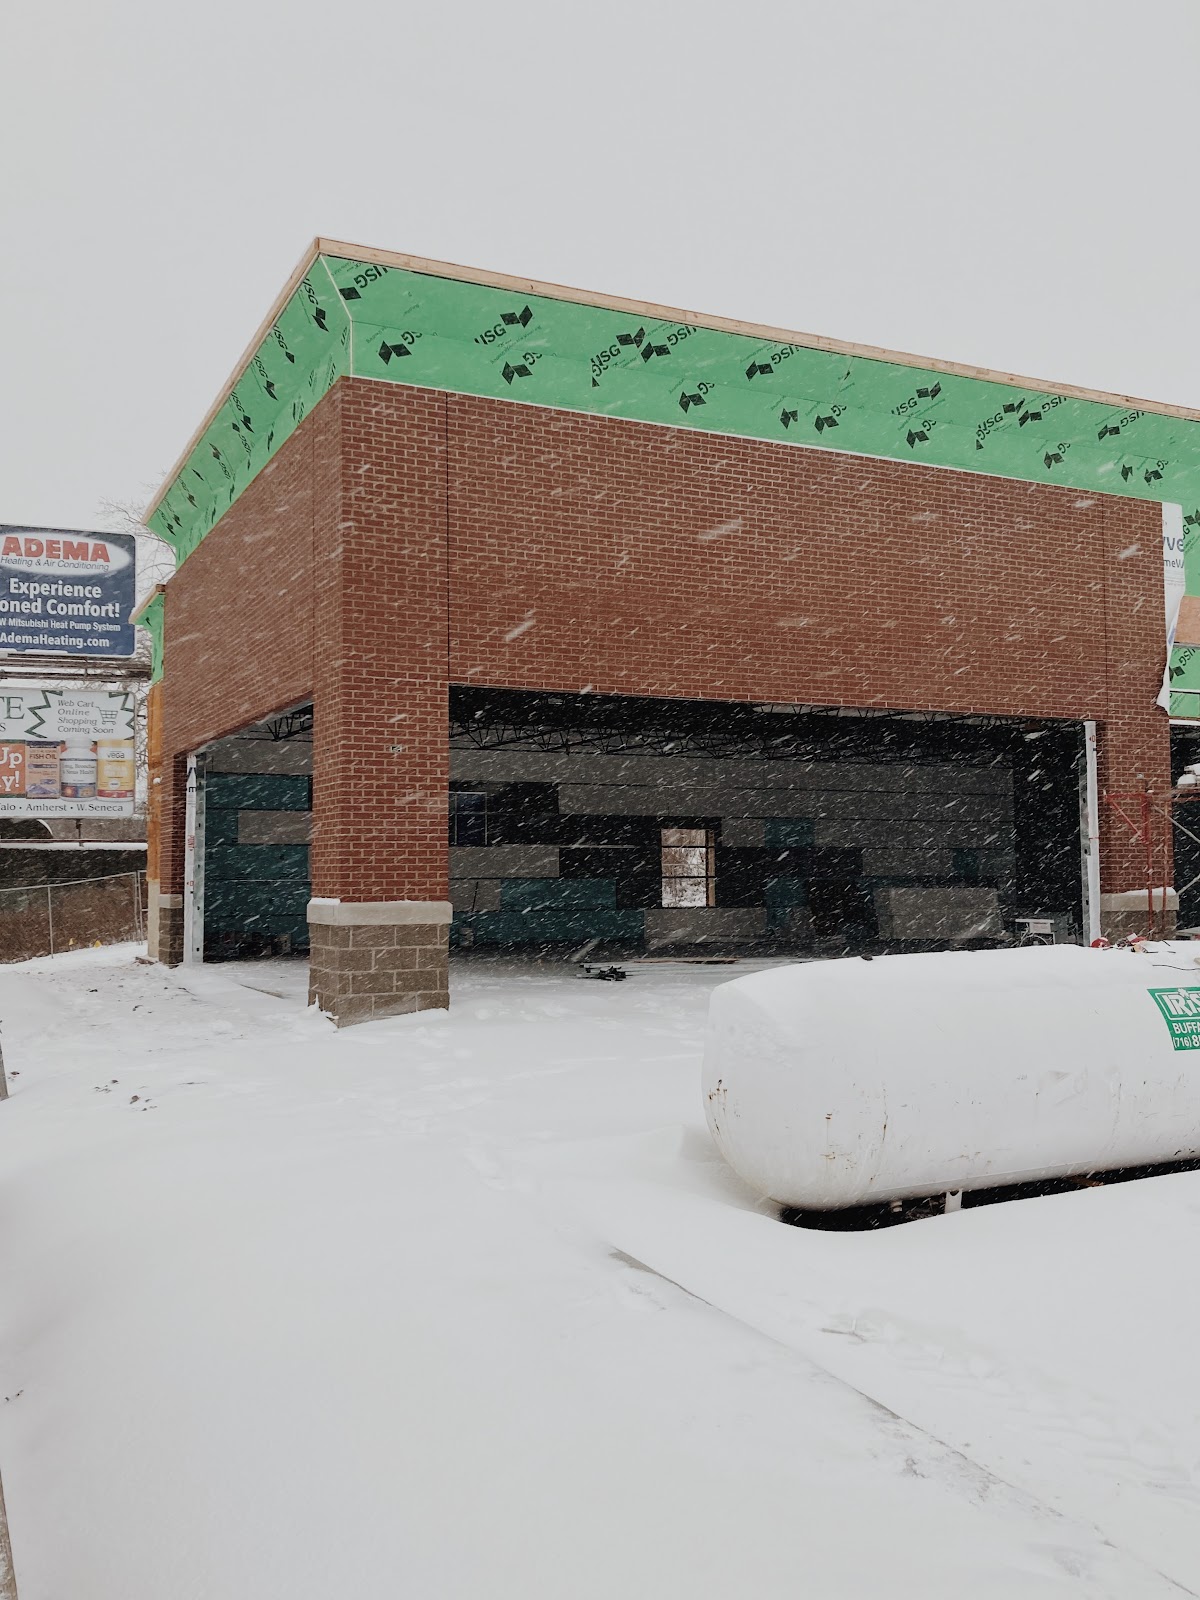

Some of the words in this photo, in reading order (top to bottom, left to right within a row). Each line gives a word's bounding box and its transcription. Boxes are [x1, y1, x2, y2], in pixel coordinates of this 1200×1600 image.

[2, 536, 111, 562] ADEMA
[0, 555, 33, 568] Heating
[35, 558, 42, 566] &
[43, 559, 56, 567] Air
[57, 560, 110, 572] Conditioning
[9, 577, 102, 599] Experience
[0, 598, 42, 614] oned
[46, 599, 120, 618] Comfort!
[8, 617, 49, 629] Mitsubishi
[50, 620, 69, 630] Heat
[69, 621, 92, 632] Pump
[93, 621, 121, 632] System
[0, 631, 110, 649] AdemaHeating.com
[58, 699, 75, 707] Web
[77, 700, 95, 708] Cart
[58, 708, 90, 716] Online
[57, 716, 98, 727] Shopping
[57, 725, 91, 735] Coming
[92, 726, 114, 734] Soon
[0, 801, 16, 811] alo
[25, 802, 67, 812] Amherst
[1173, 1036, 1192, 1048] (716)
